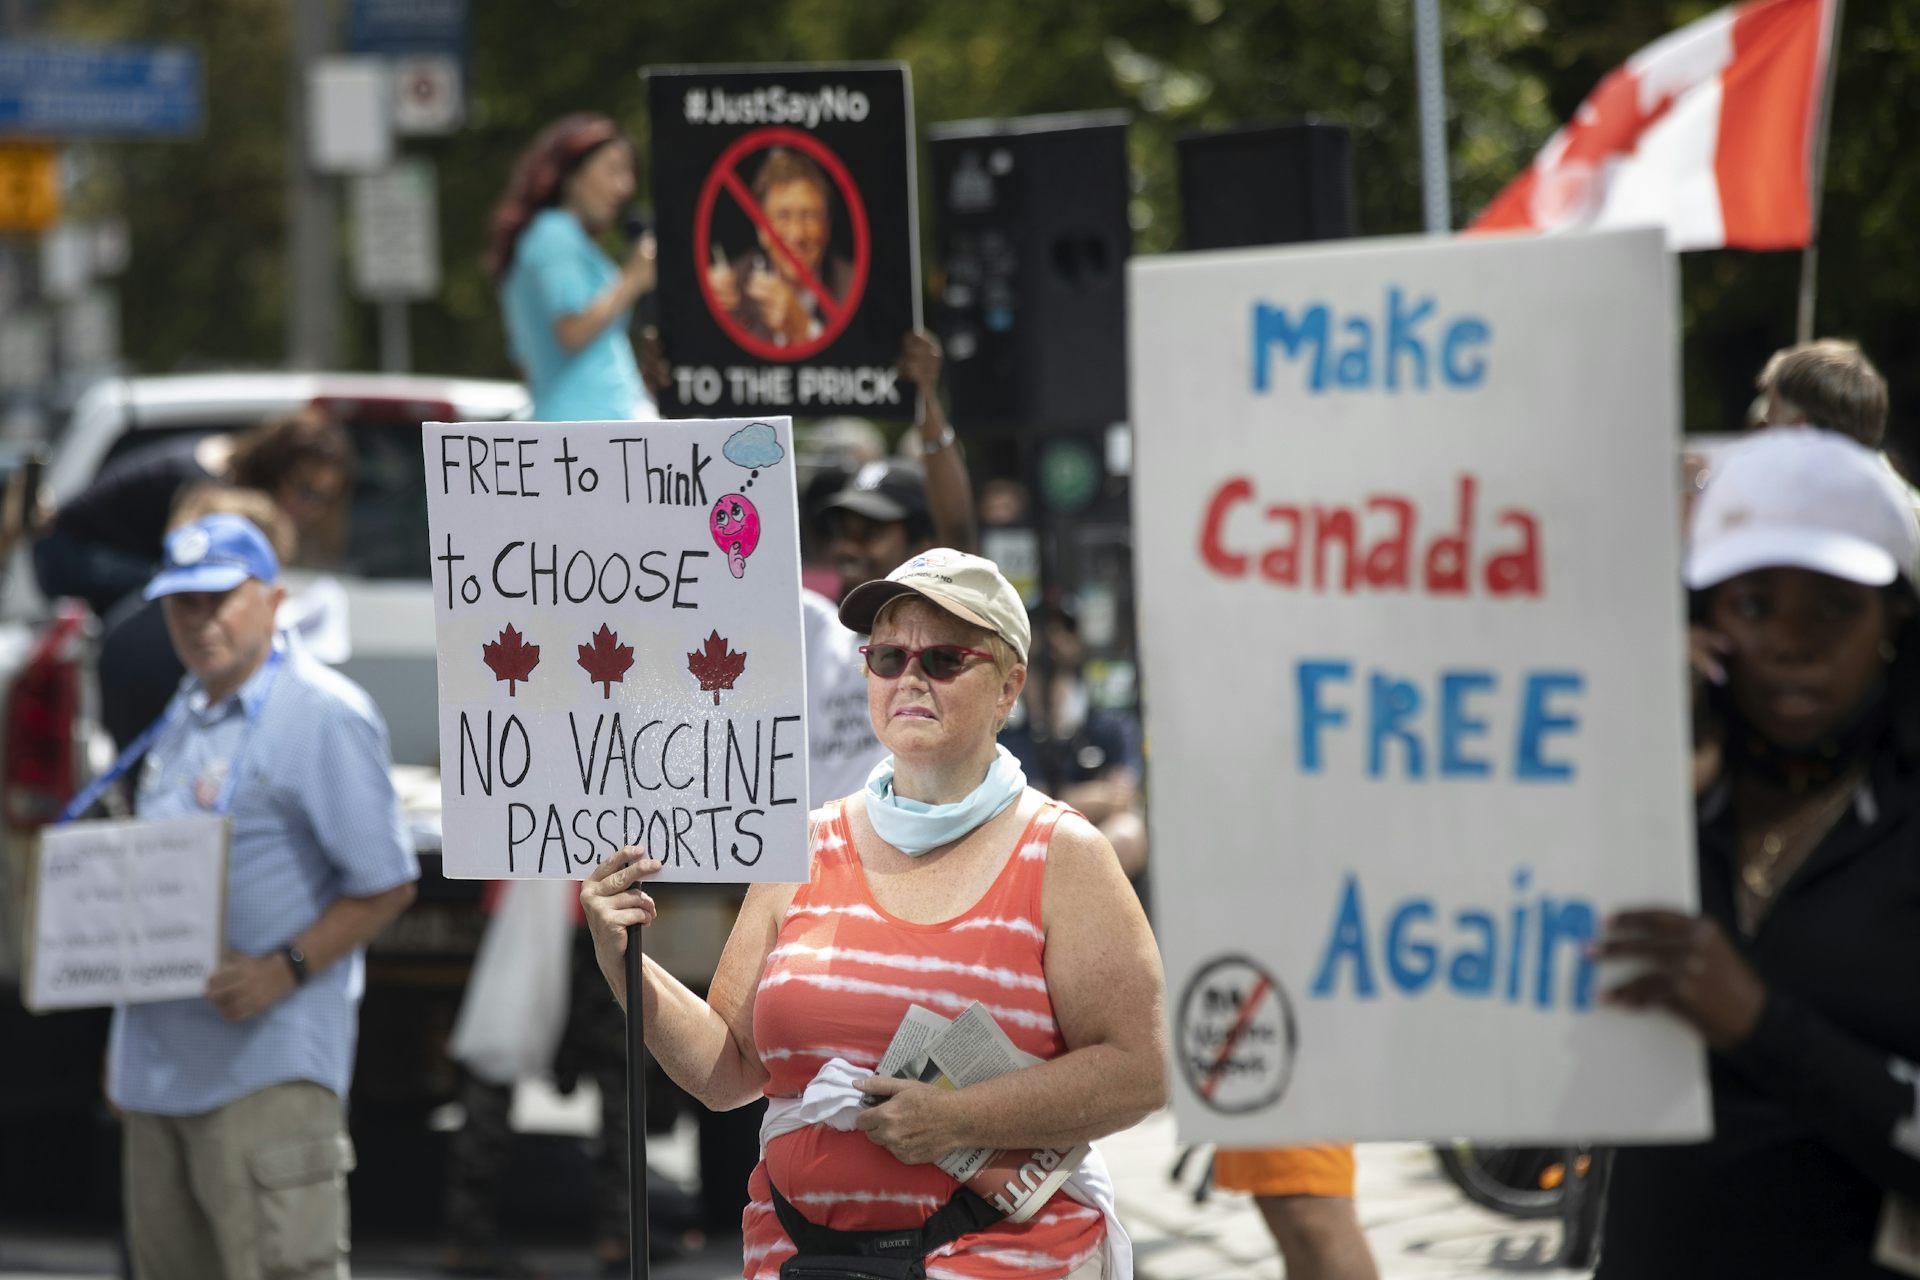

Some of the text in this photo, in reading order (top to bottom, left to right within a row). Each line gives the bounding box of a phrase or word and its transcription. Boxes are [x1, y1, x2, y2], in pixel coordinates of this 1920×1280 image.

[684, 86, 870, 128] #JustSayNo
[1250, 286, 1491, 393] Make
[674, 366, 900, 405] TO THE PRICK
[441, 435, 712, 506] FREE to Think
[1196, 470, 1545, 598] Canada
[437, 533, 709, 610] to CHOOSE
[1294, 659, 1585, 781] FREE
[461, 710, 800, 806] NO VACCINE
[508, 803, 765, 874] PASSPORTS
[994, 1146, 1076, 1216] RUTH
